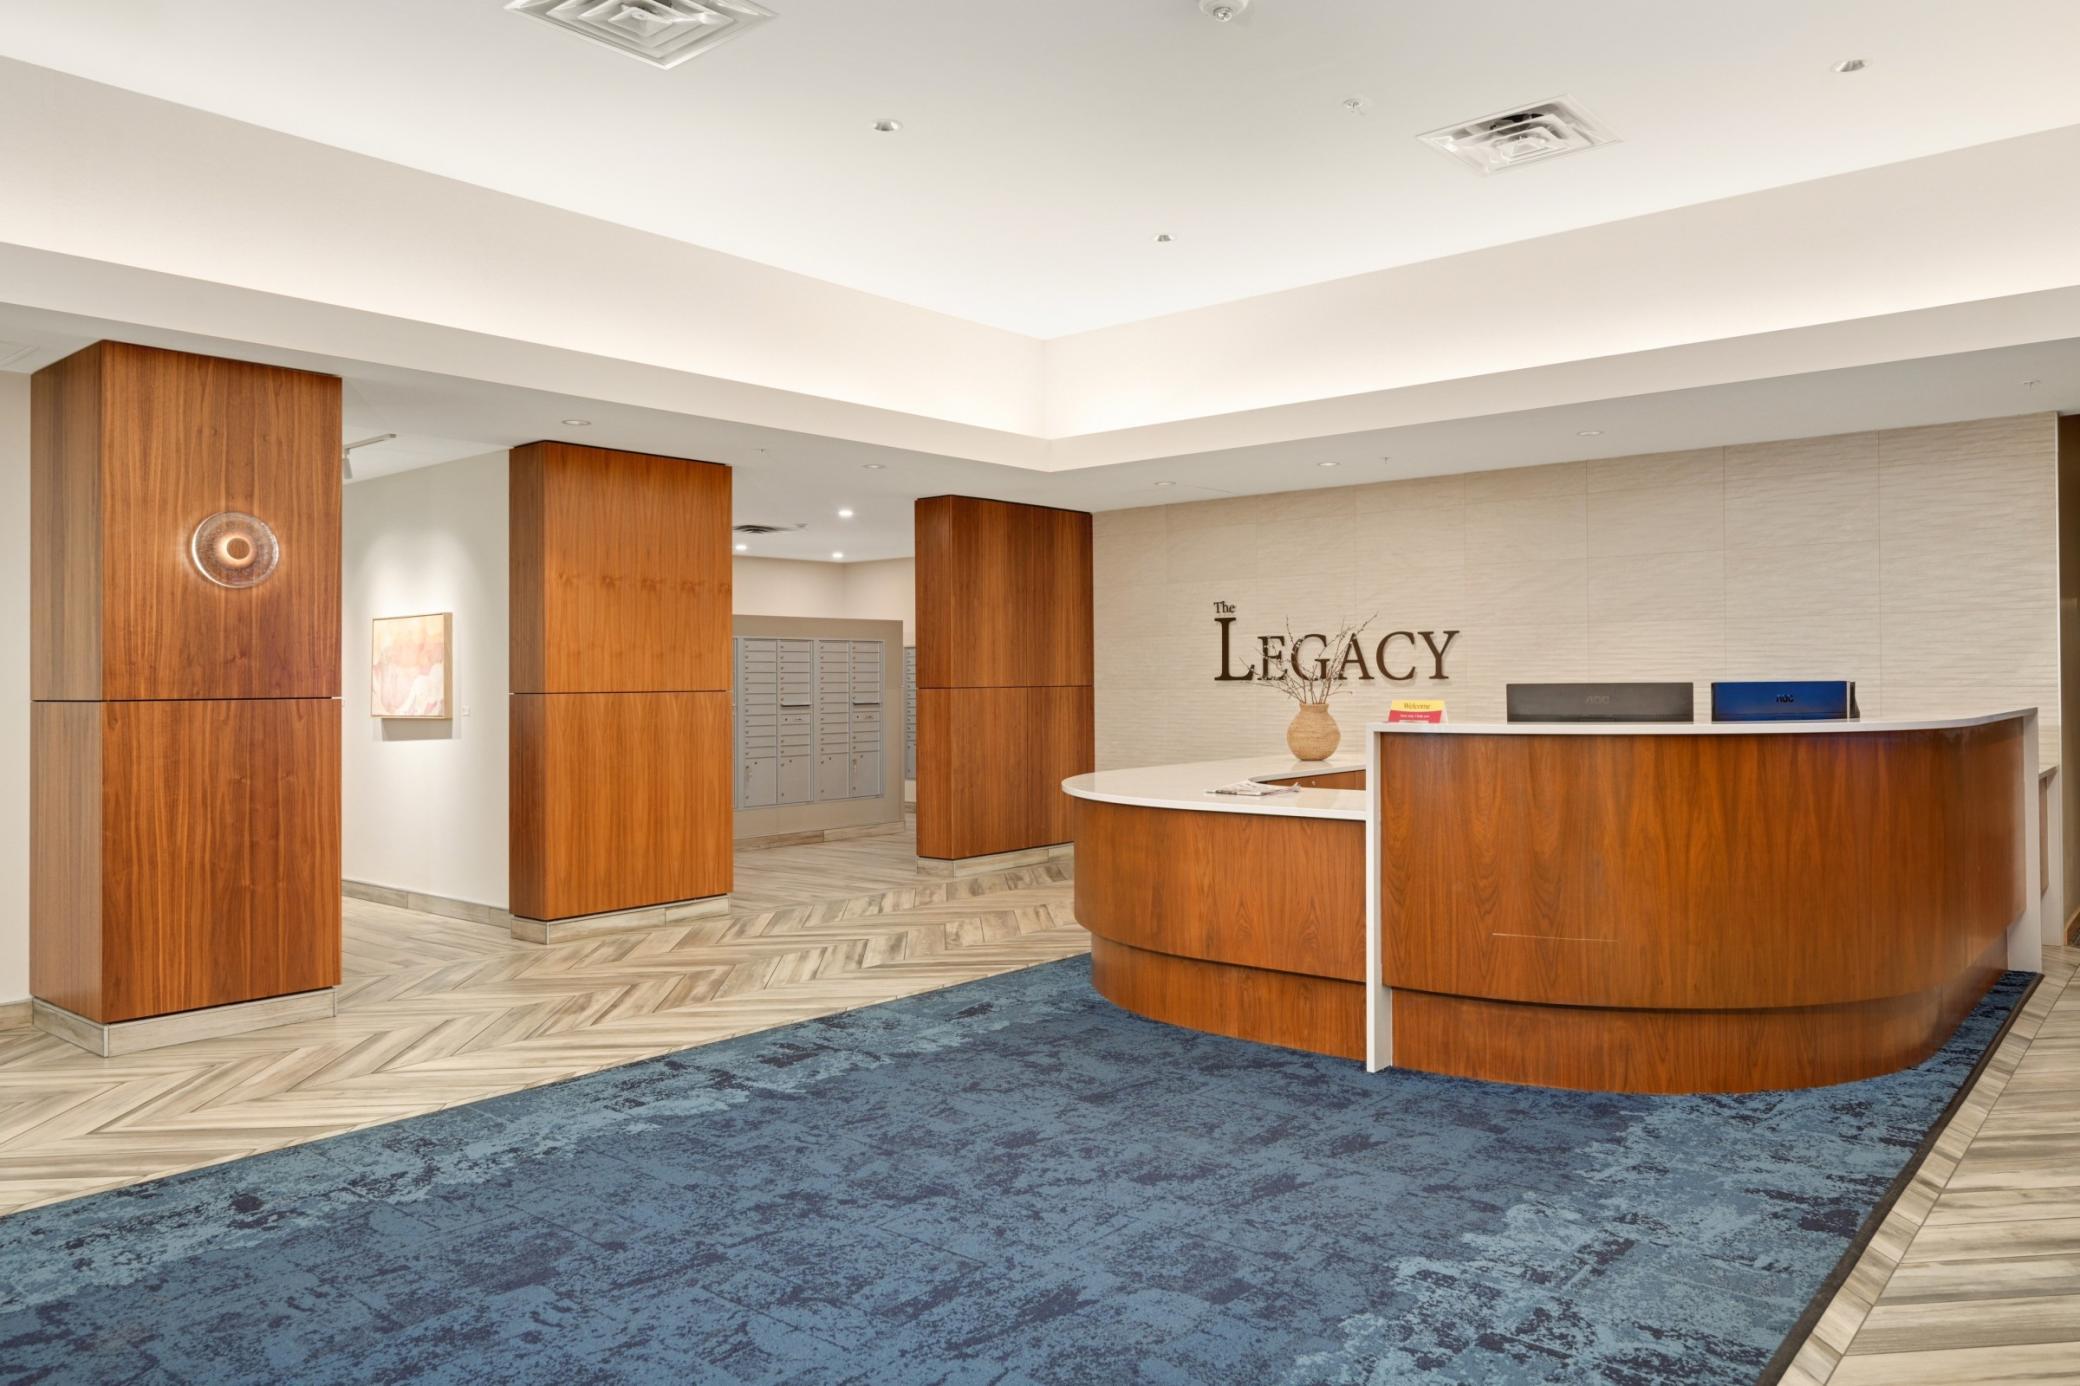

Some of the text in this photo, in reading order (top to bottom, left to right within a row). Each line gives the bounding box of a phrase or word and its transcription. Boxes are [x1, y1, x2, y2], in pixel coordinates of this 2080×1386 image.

[1213, 600, 1236, 613] The
[1213, 617, 1460, 681] LEGACY
[1403, 702, 1431, 710] Welcome
